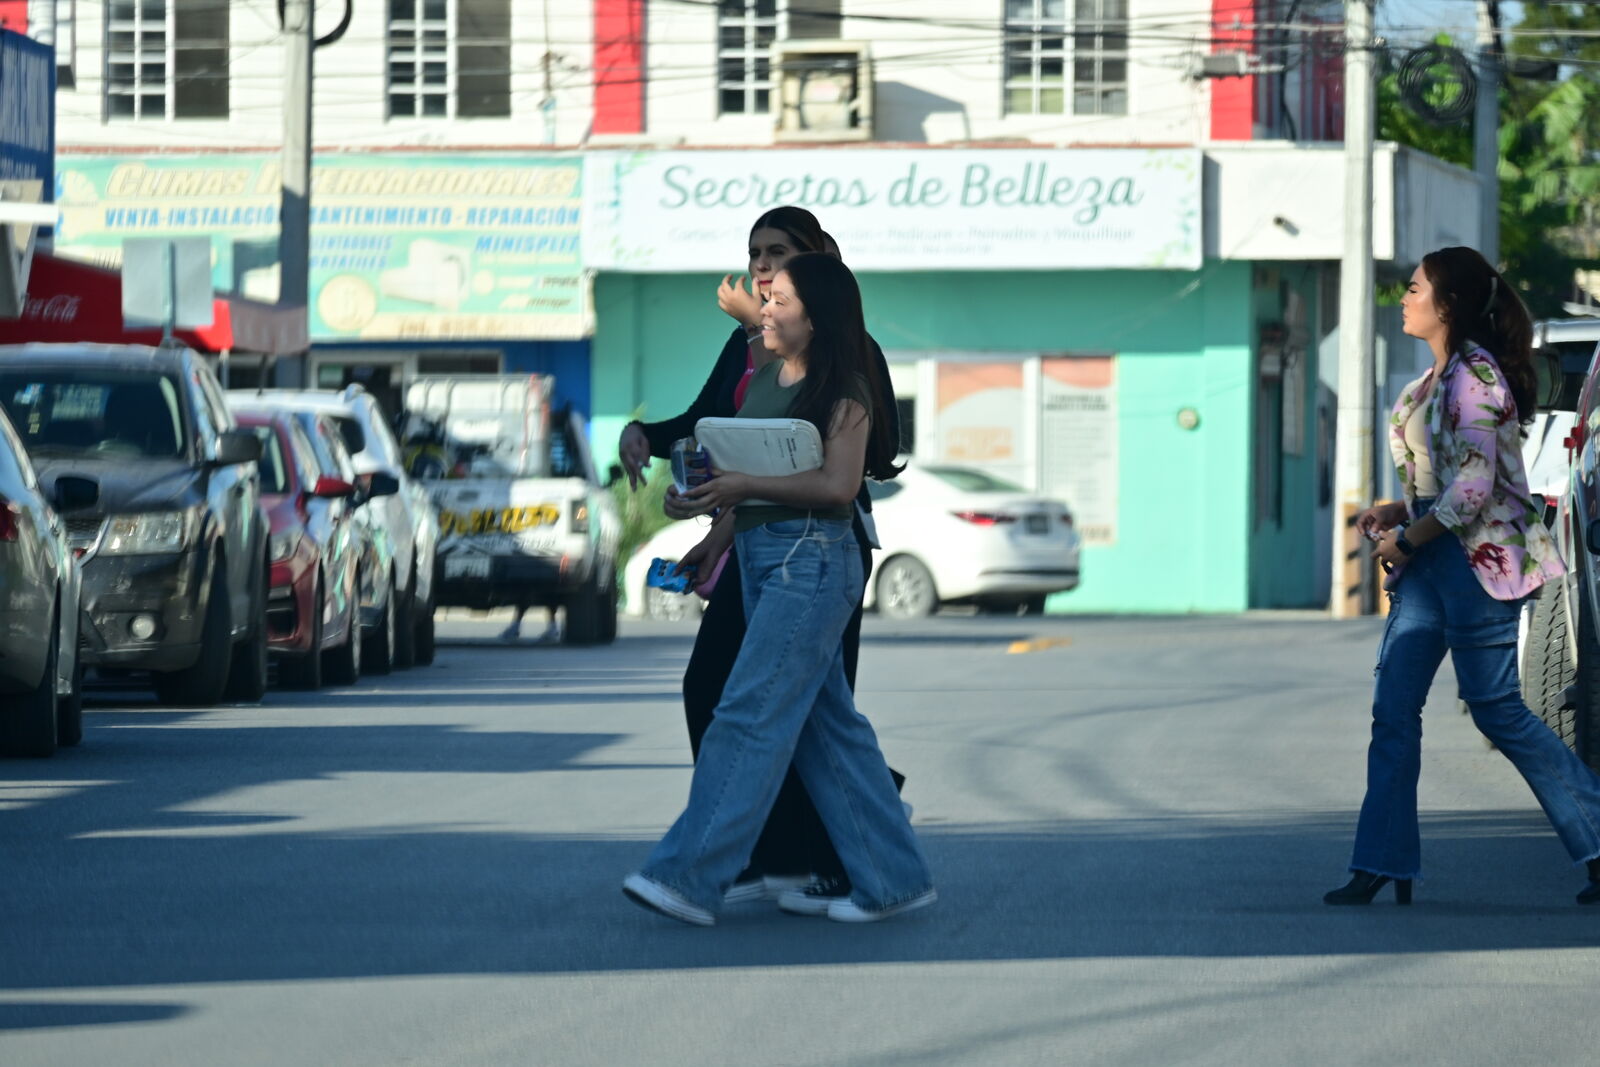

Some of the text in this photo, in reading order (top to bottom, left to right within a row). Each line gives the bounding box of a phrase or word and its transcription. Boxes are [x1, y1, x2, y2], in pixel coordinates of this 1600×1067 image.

[107, 162, 579, 197] CLIMAS IERNACIONALES
[658, 160, 1145, 226] Secretos de Belleza
[466, 206, 580, 226] REPARACIÓN
[475, 235, 581, 251] MINISPLIT
